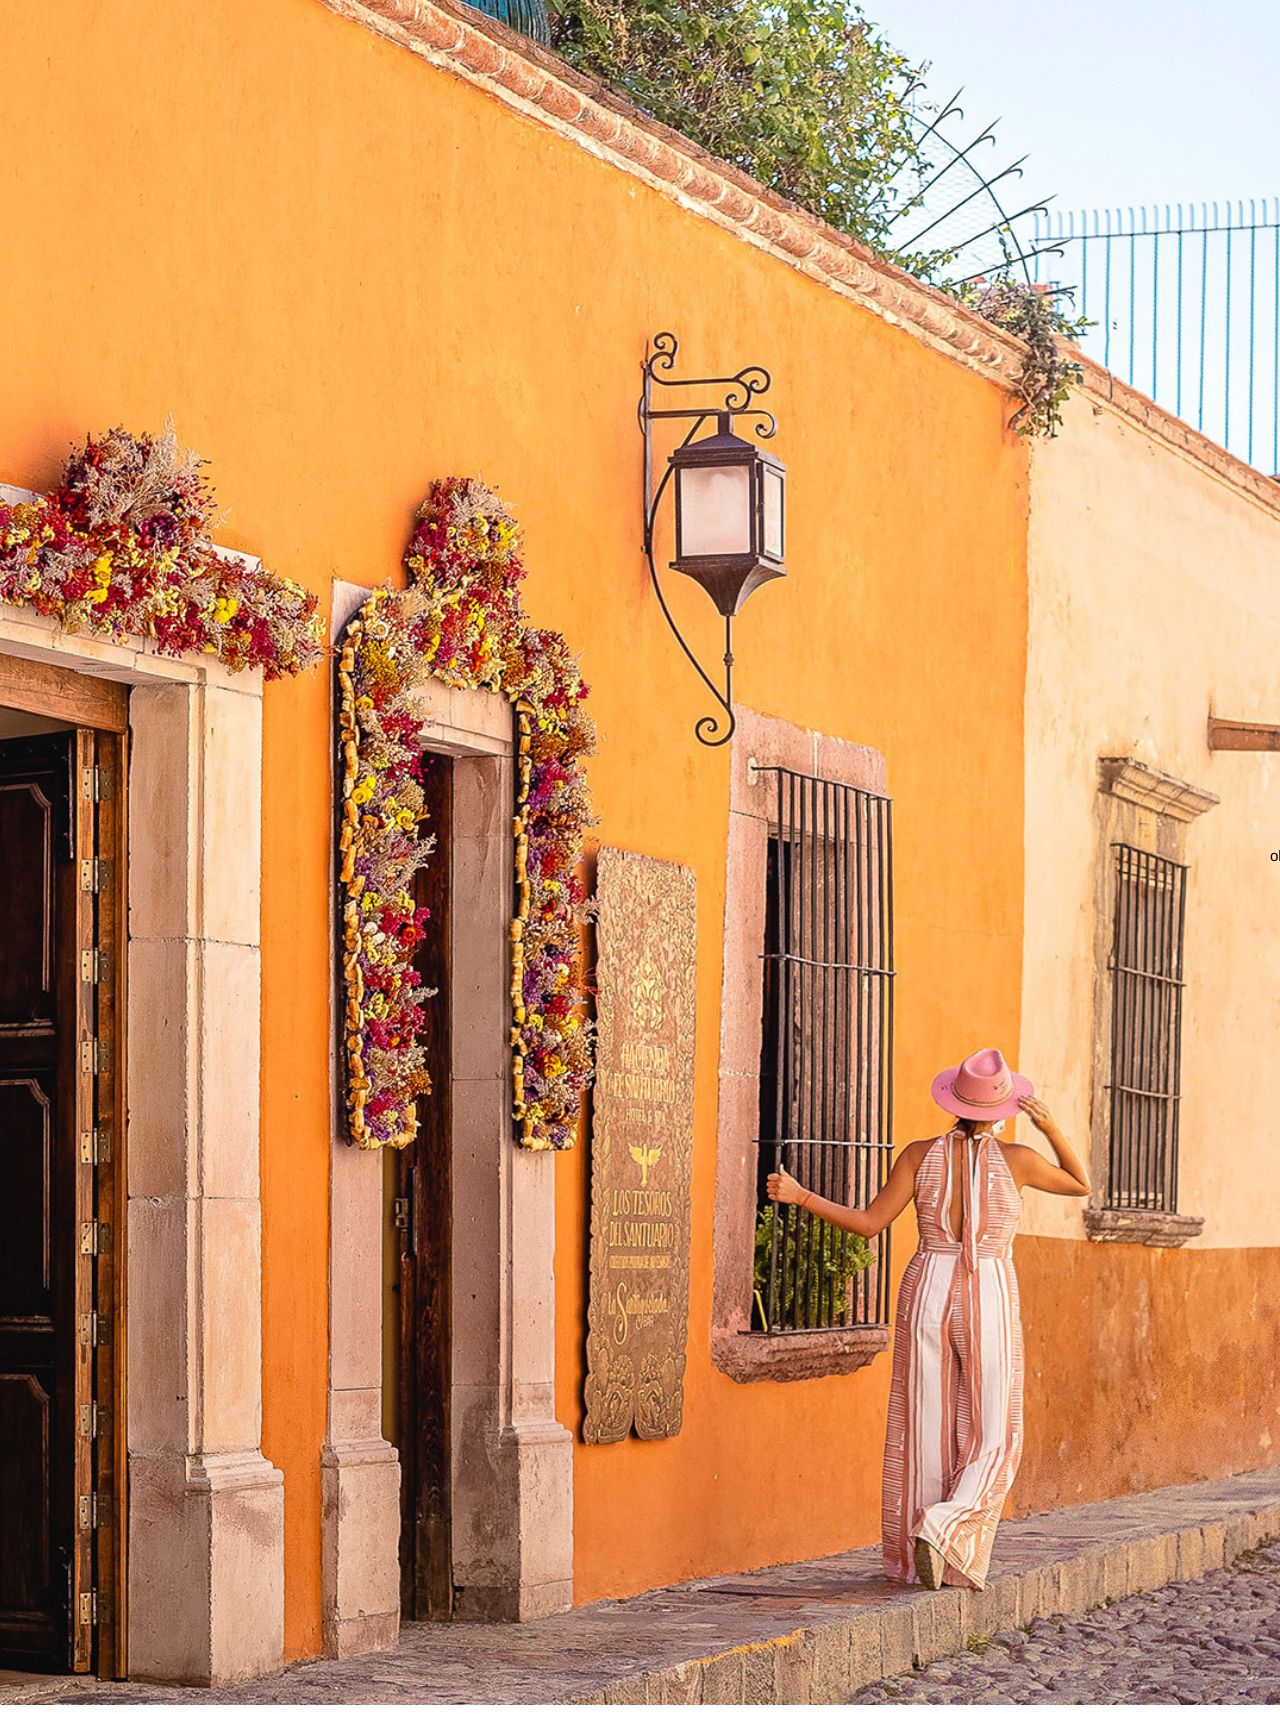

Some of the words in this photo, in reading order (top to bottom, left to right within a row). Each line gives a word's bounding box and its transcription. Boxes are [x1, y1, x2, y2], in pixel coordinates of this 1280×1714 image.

[612, 1189, 630, 1216] LOS
[631, 1190, 672, 1217] TESOROS
[609, 1221, 622, 1247] DEL
[623, 1221, 674, 1247] SANTUARIO
